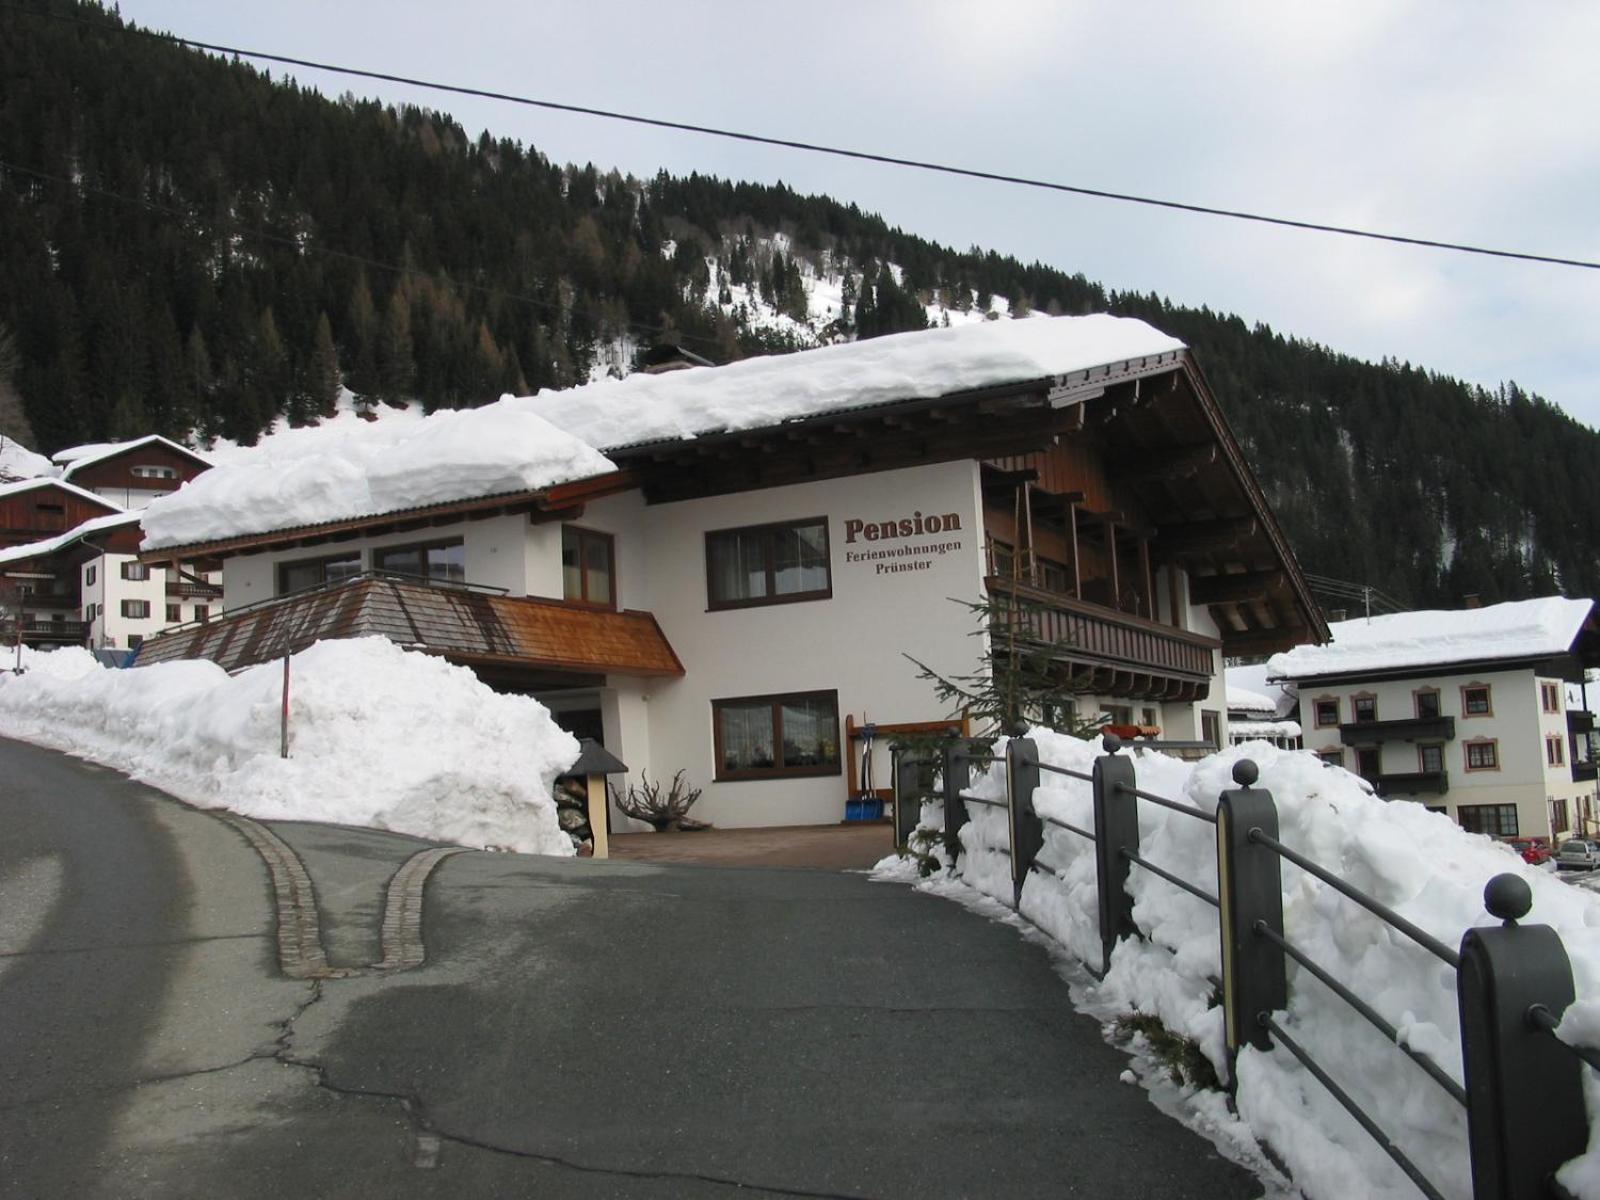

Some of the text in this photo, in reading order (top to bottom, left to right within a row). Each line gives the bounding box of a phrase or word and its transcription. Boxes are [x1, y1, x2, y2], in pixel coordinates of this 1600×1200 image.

[844, 511, 962, 543] Pension
[846, 541, 961, 562] Ferienwohnungen
[876, 560, 932, 574] Prünster
